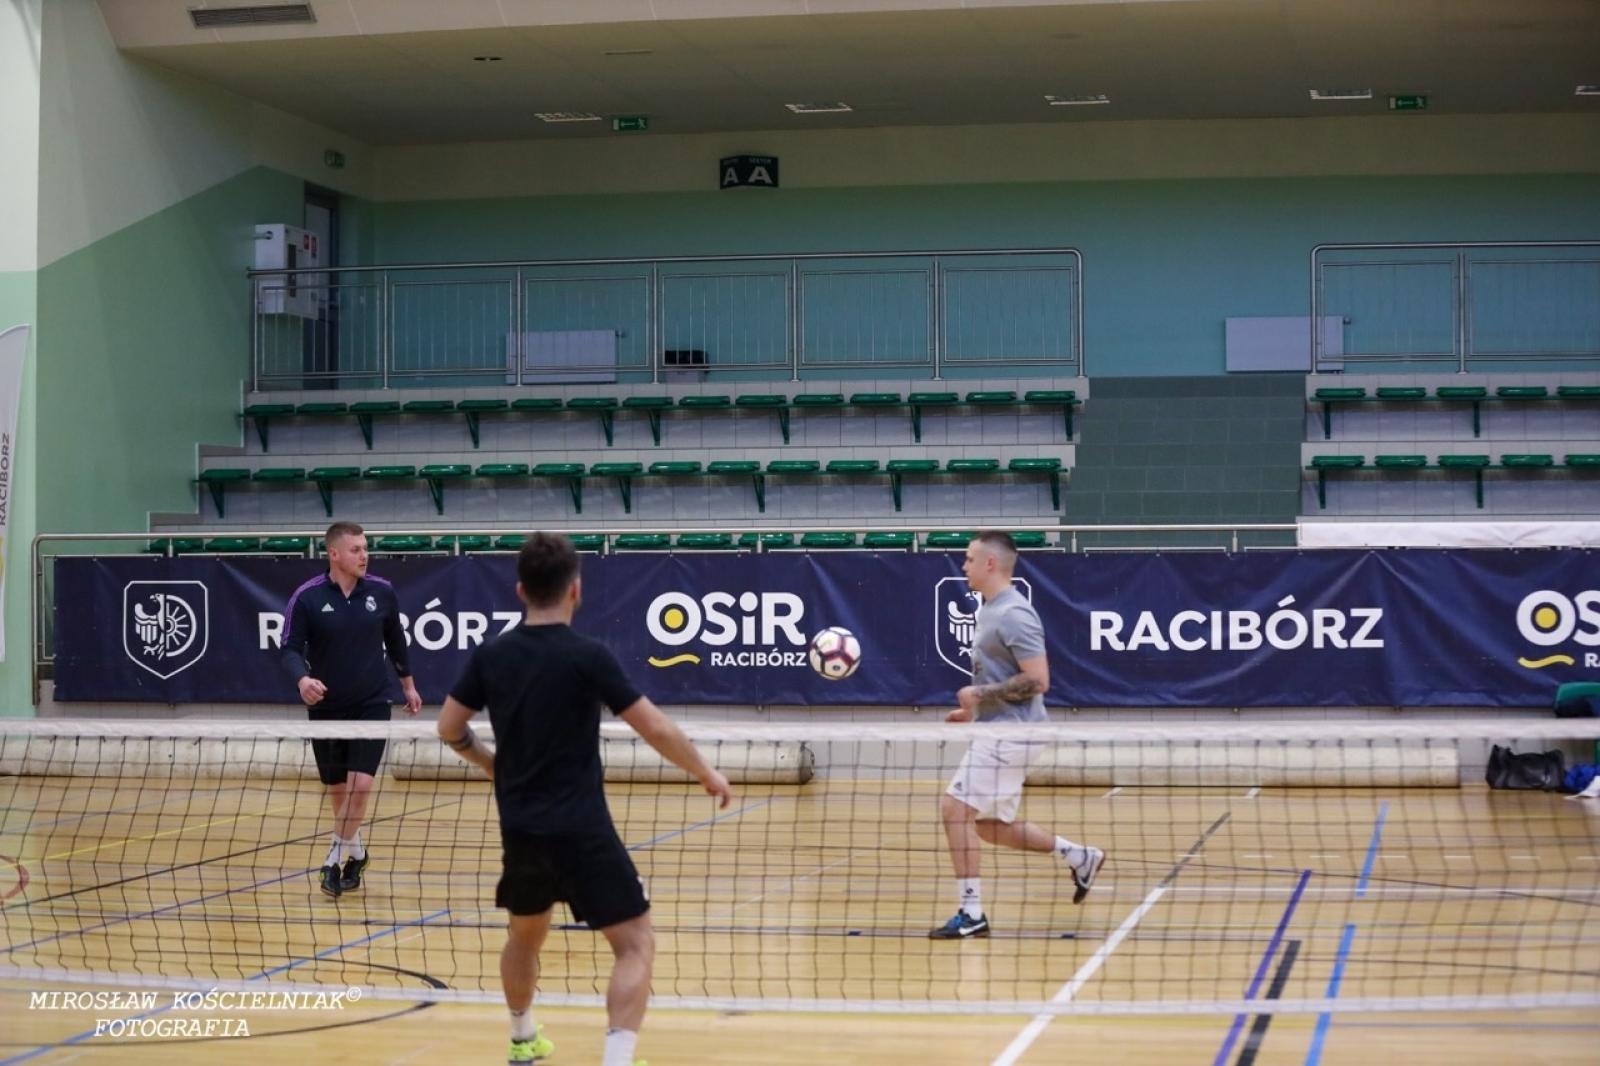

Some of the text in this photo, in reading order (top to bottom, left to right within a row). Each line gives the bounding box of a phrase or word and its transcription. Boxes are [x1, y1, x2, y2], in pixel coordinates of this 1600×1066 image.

[723, 167, 739, 186] A
[748, 166, 773, 184] A
[1090, 594, 1384, 651] RACIBÓRZ
[711, 648, 807, 667] RACIBÓRZ
[1584, 652, 1600, 668] R
